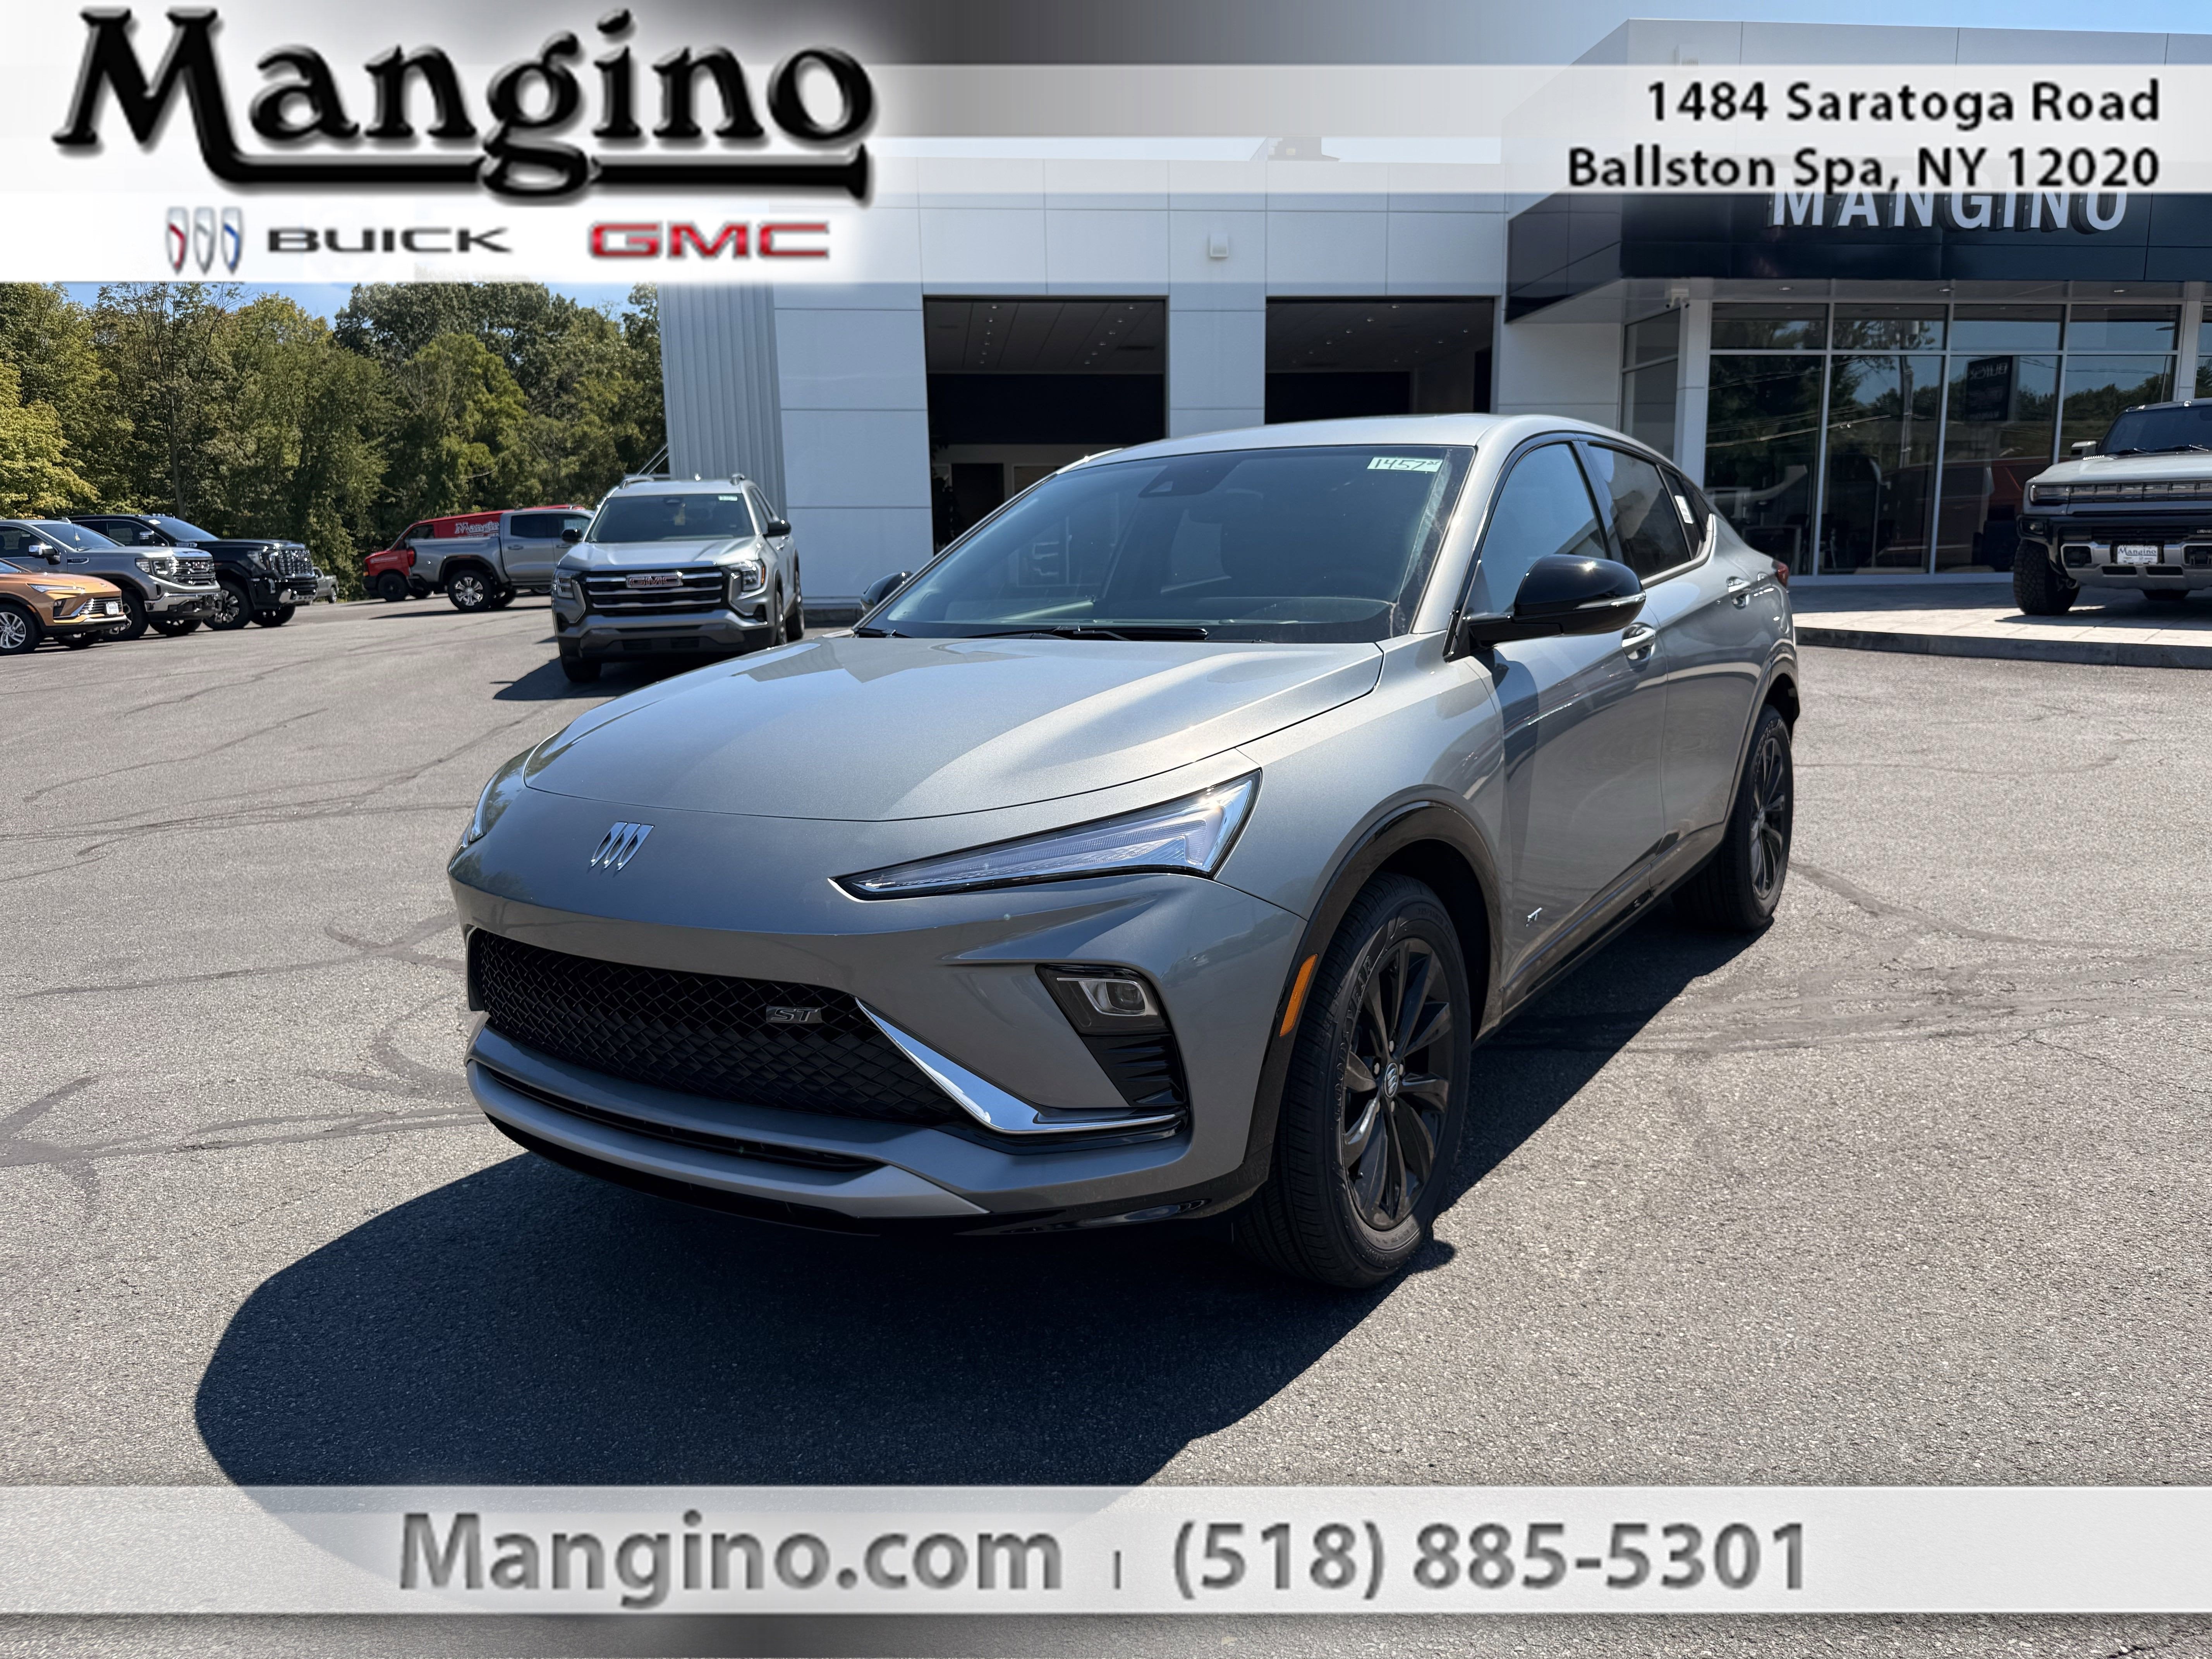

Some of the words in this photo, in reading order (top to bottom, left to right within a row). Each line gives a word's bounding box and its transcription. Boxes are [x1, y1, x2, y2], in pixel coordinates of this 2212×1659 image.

[1771, 170, 2128, 232] MANGINO
[2118, 546, 2156, 556] Mangino
[630, 575, 678, 587] GMC
[771, 1008, 818, 1022] ST
